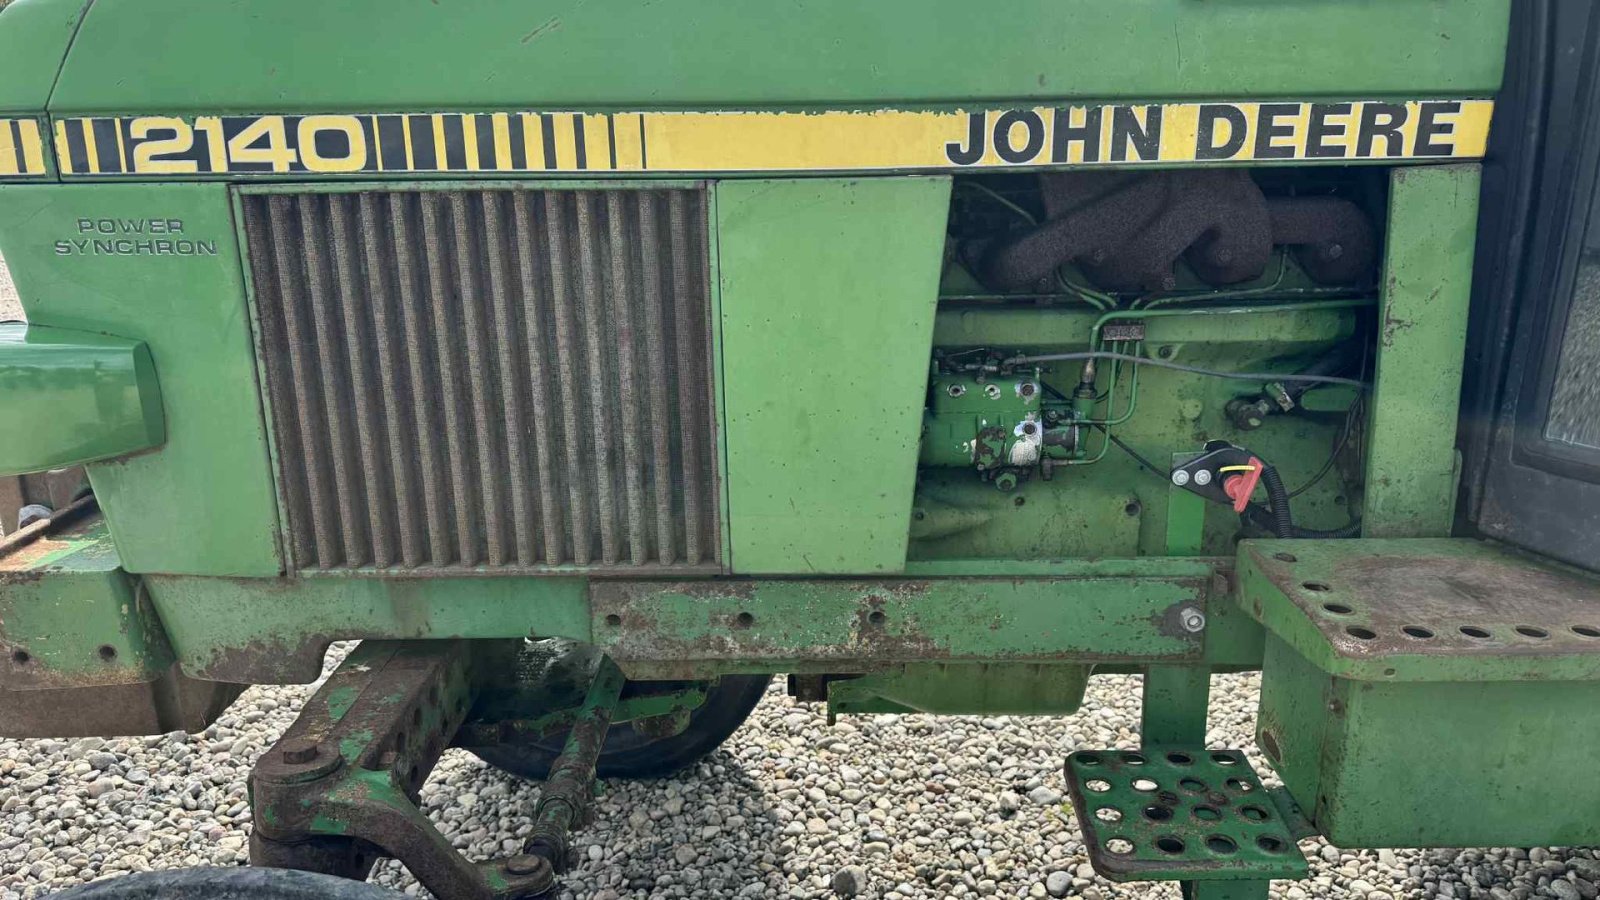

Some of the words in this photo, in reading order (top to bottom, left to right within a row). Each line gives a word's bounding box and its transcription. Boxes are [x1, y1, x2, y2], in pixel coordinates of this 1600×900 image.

[130, 115, 367, 173] 2140
[946, 105, 1161, 165] JOHN
[1196, 102, 1461, 161] DEERE
[77, 218, 184, 235] POWER
[54, 239, 217, 256] SYNCHRON
